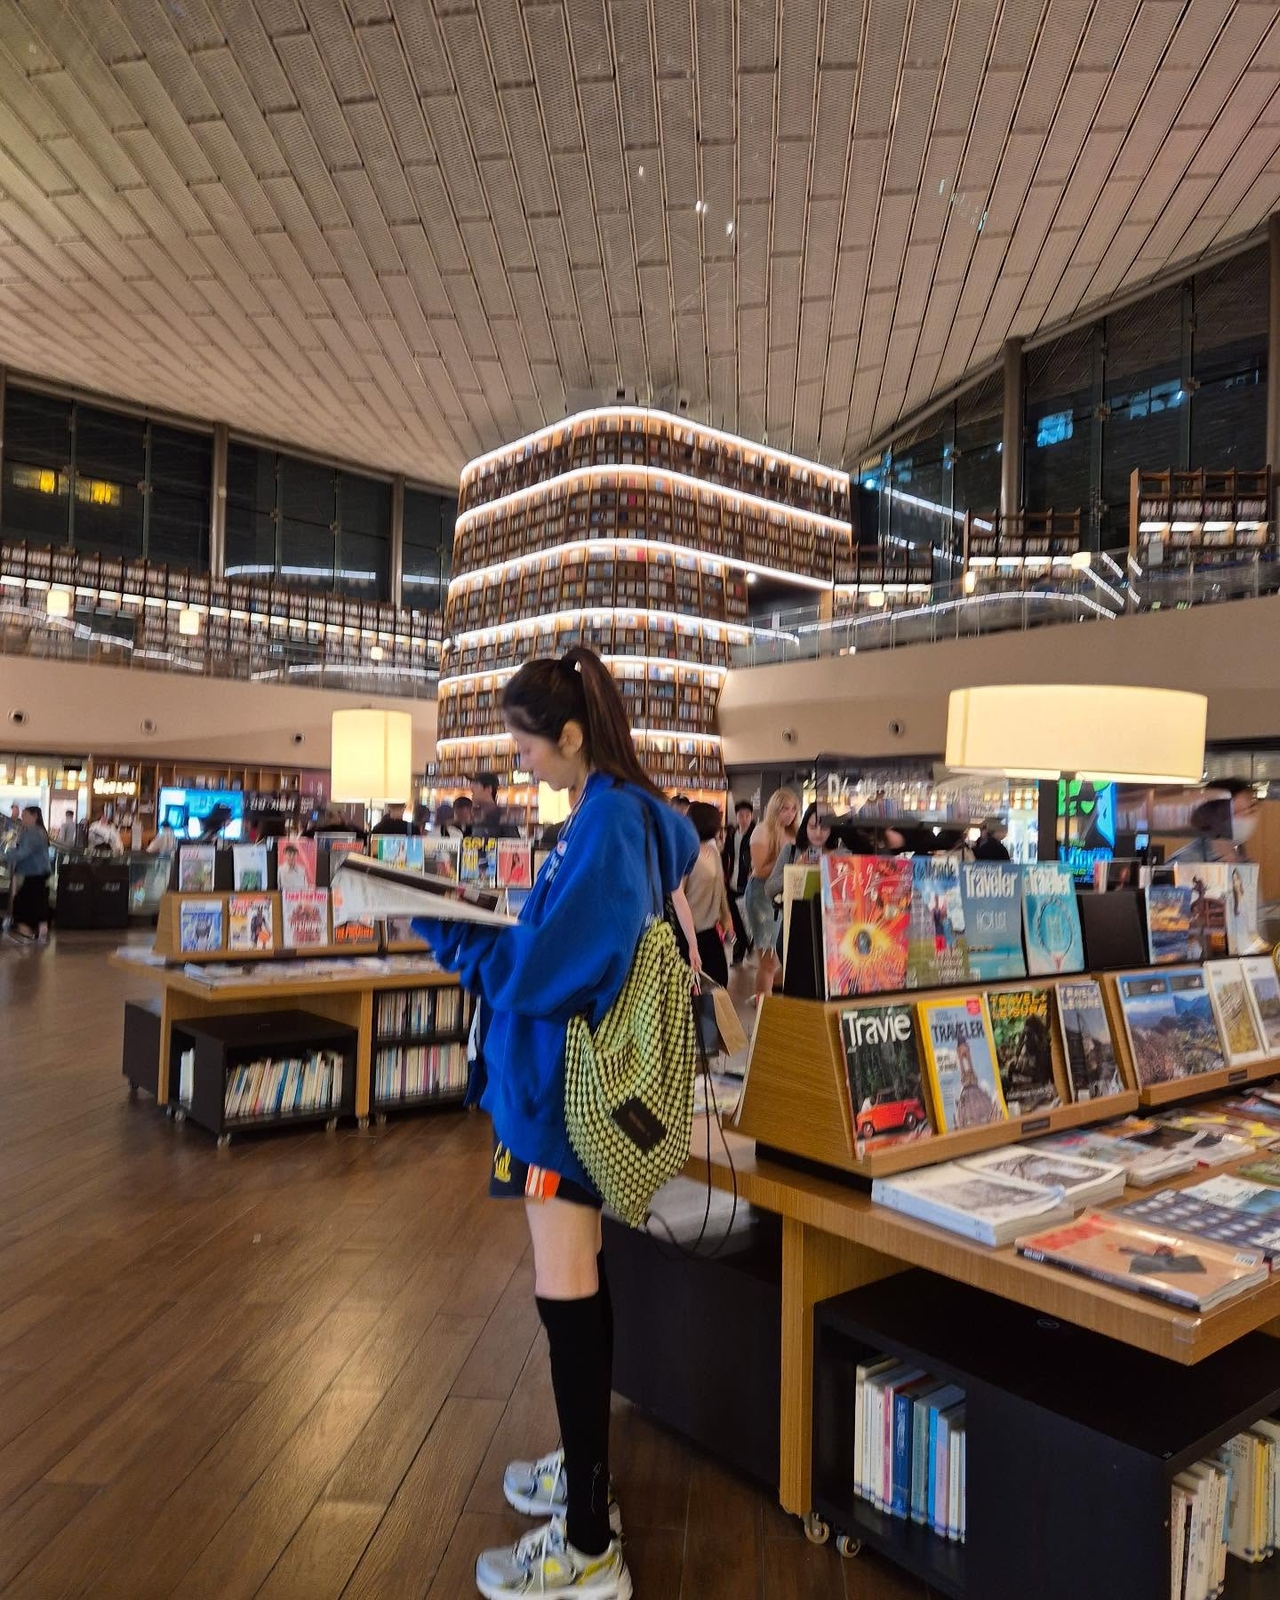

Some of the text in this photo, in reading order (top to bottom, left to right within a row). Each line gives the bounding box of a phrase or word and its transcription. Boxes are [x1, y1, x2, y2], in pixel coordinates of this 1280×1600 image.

[963, 864, 1018, 898] Traveler
[842, 1009, 912, 1047] Travie
[931, 1020, 985, 1044] TRAVELER
